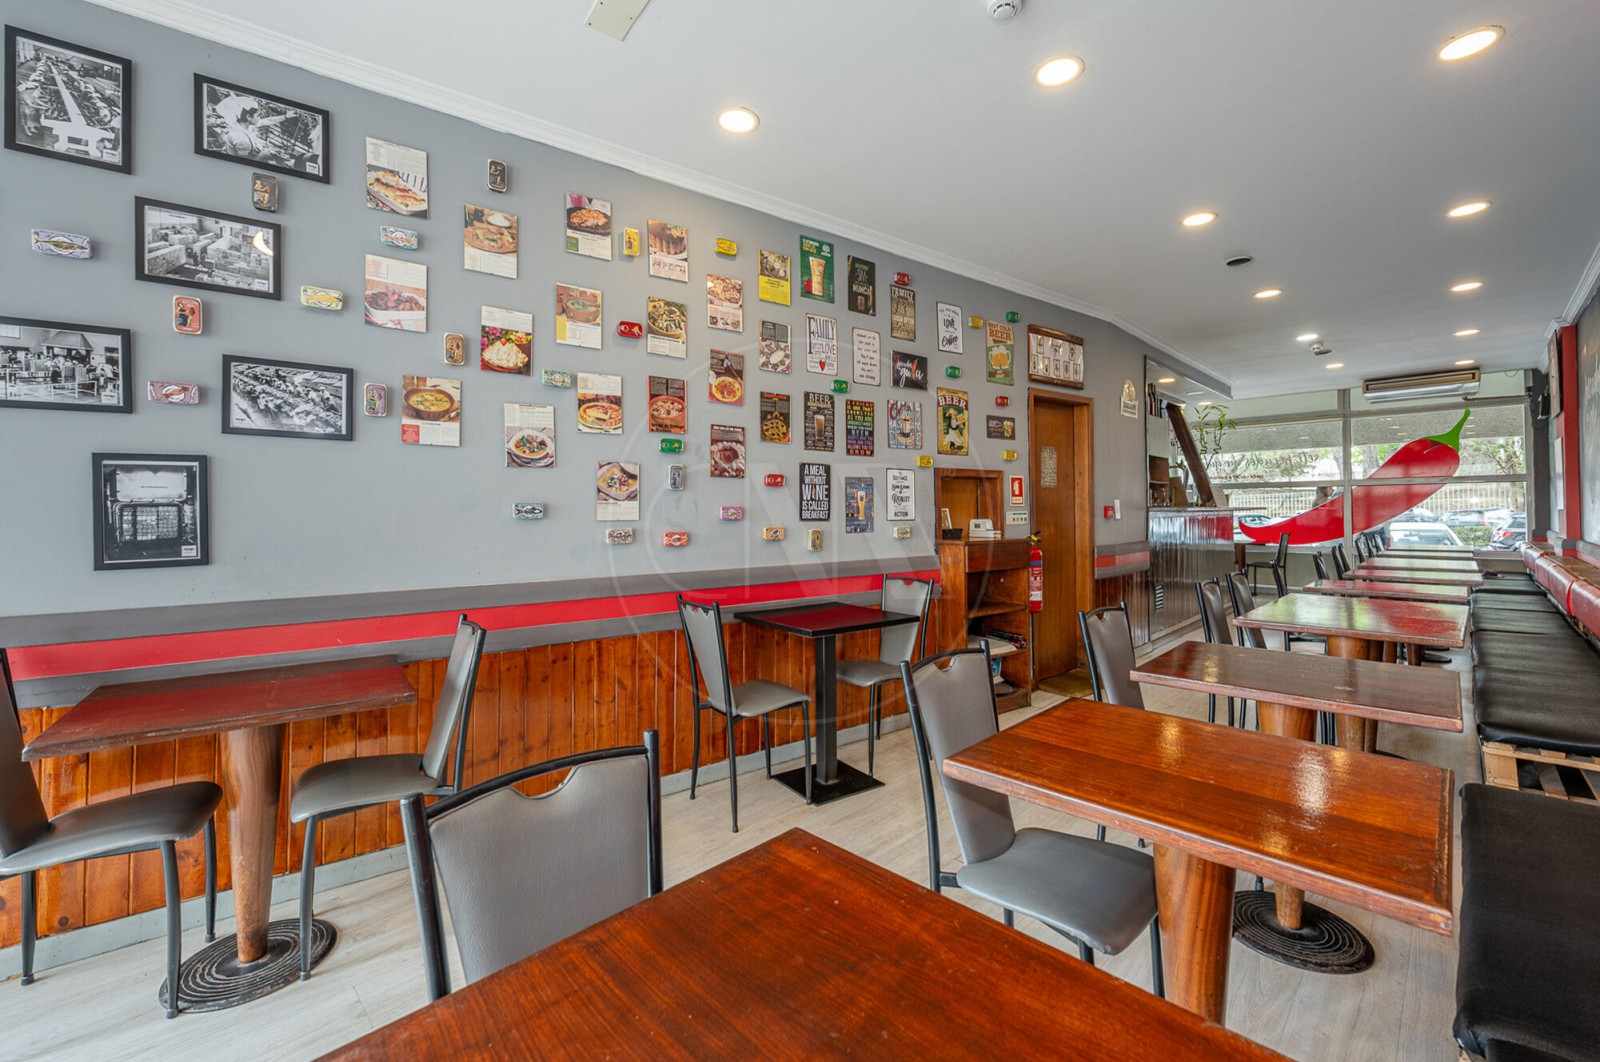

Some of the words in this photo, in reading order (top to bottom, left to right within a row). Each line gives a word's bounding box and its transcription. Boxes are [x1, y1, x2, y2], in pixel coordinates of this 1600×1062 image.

[892, 286, 914, 301] FAMILY
[943, 318, 958, 331] LOVE
[942, 334, 958, 347] Coffee
[989, 328, 1012, 341] BEER
[822, 343, 836, 356] LOVE
[900, 359, 924, 388] gula
[809, 393, 830, 404] BEER
[938, 396, 966, 408] BEER
[804, 464, 809, 474] A
[810, 464, 826, 476] MEAL
[804, 476, 826, 484] WITHOUT
[802, 484, 828, 500] WINE
[802, 501, 807, 510] IS
[808, 501, 828, 510] CALLED
[802, 510, 828, 519] BREAKFAST
